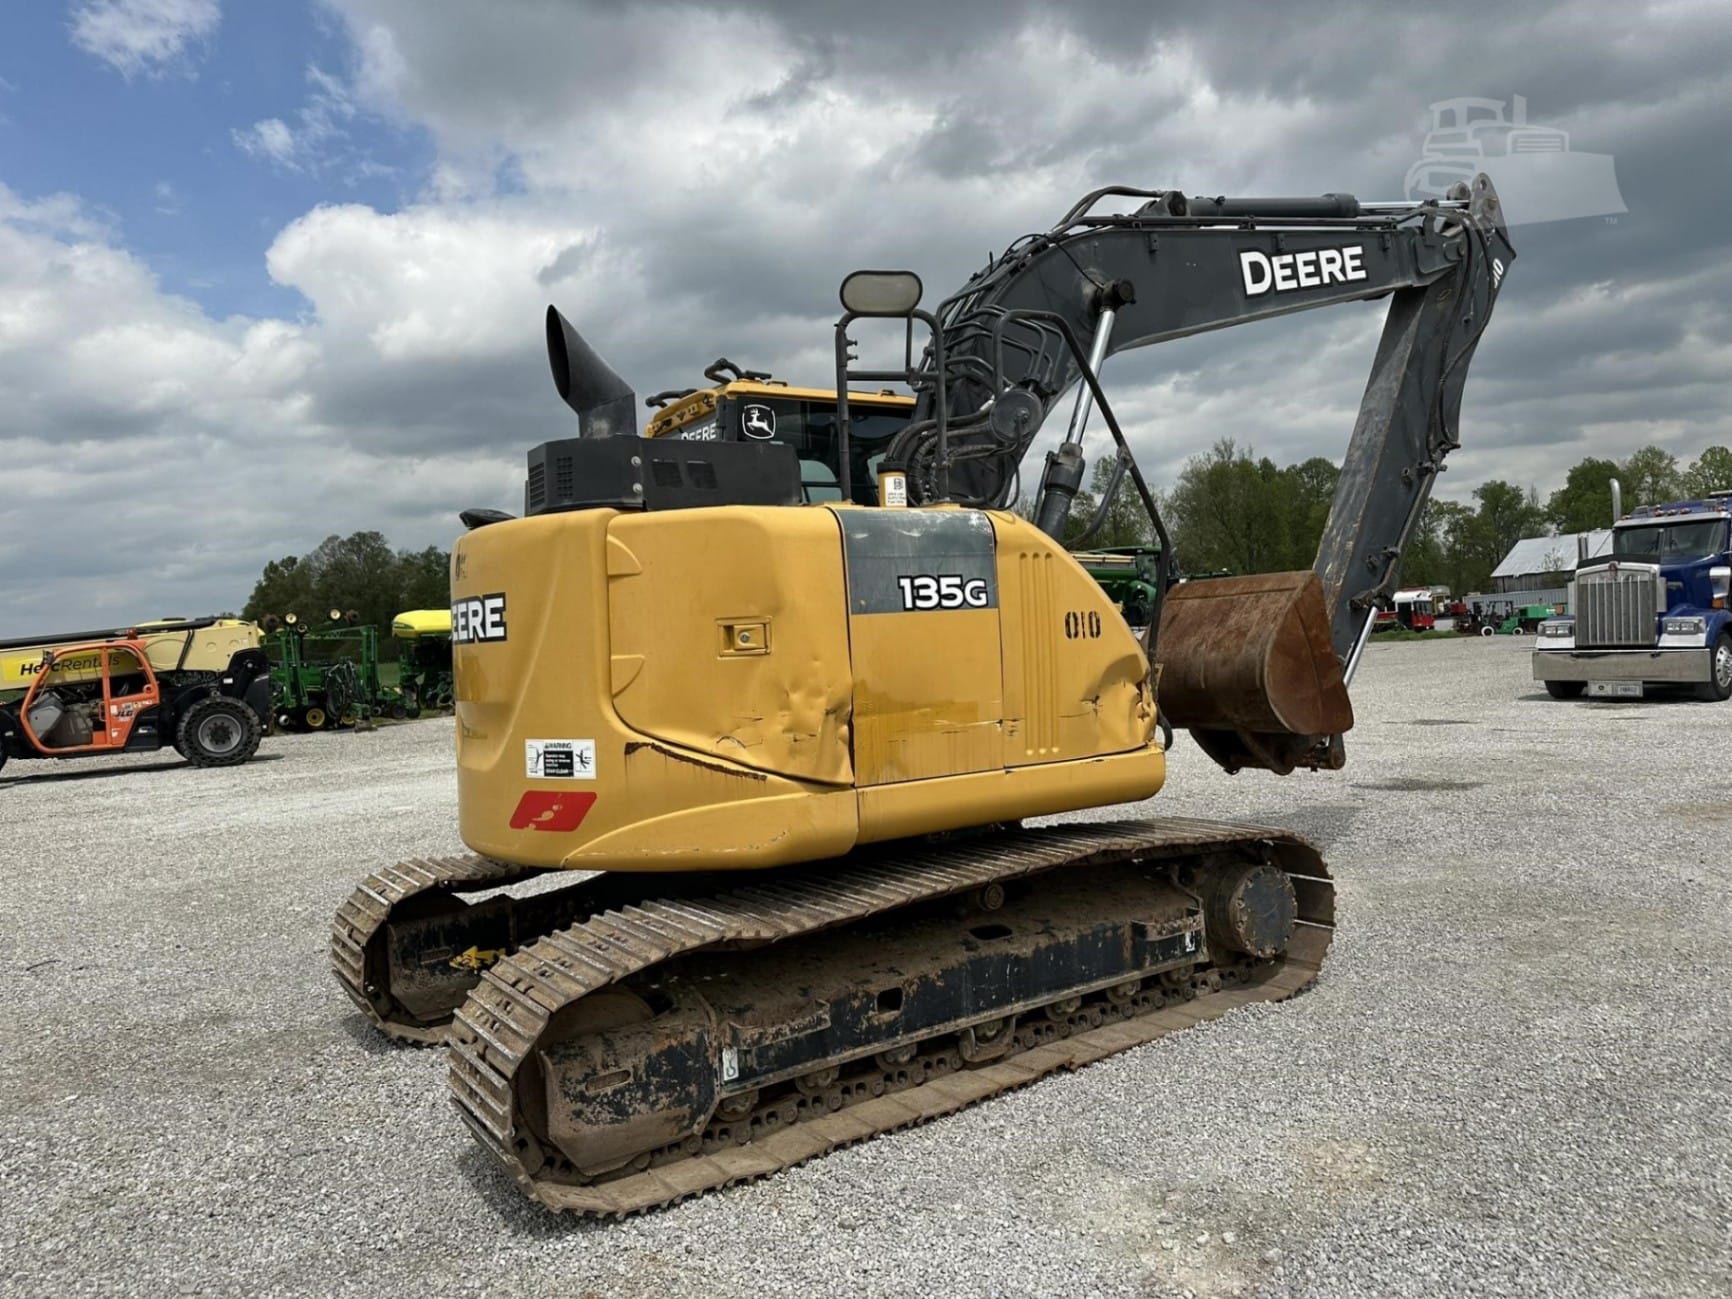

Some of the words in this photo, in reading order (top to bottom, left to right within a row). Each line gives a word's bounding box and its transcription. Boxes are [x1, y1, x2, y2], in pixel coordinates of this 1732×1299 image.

[1240, 245, 1367, 295] DEERE
[899, 577, 988, 609] 135G
[451, 597, 505, 641] EERE
[1065, 611, 1101, 640] 010
